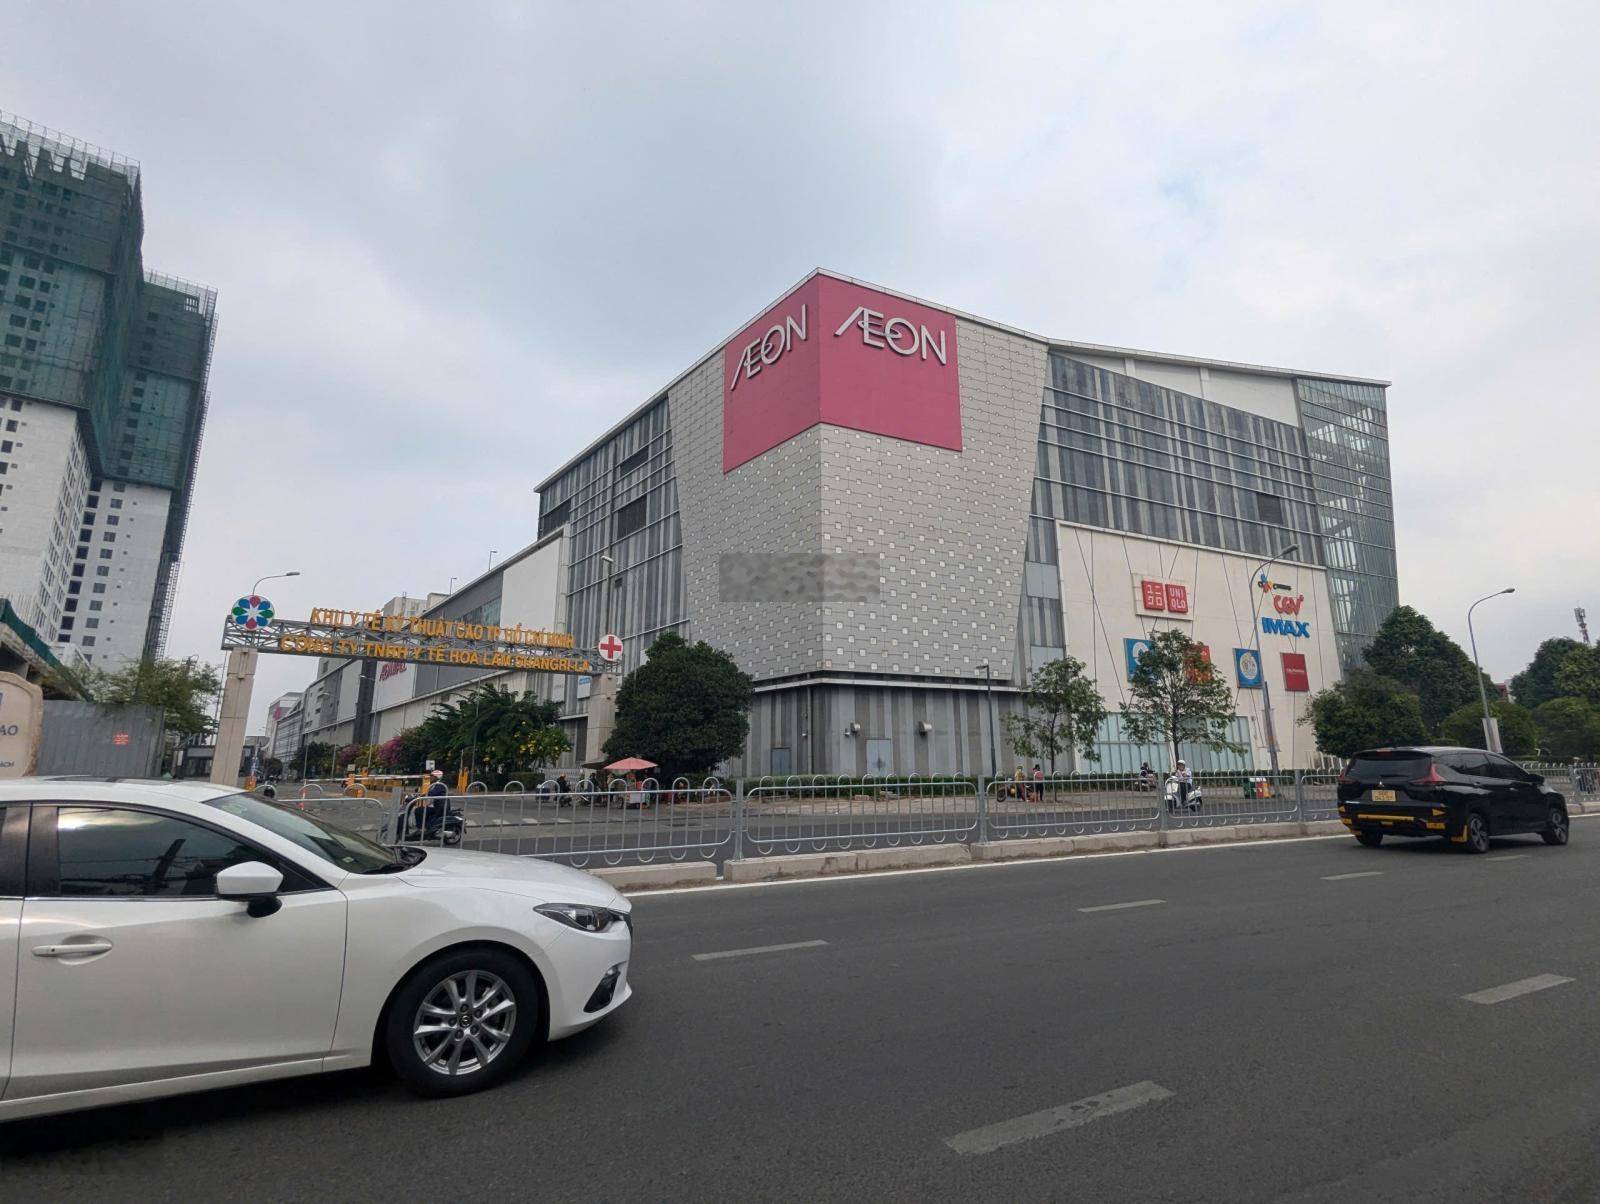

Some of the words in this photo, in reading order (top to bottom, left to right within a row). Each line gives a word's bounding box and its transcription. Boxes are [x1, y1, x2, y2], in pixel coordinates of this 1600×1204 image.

[1170, 587, 1184, 598] UNI
[1171, 598, 1186, 610] QLO
[1273, 595, 1304, 616] CGV
[349, 610, 360, 629] Y
[456, 620, 484, 641] CAO
[1261, 617, 1310, 638] IMAX
[281, 633, 333, 654] CÔNG
[340, 639, 358, 656] TY
[365, 642, 408, 660] TNHH
[413, 645, 422, 661] Y
[449, 648, 479, 664] HOA
